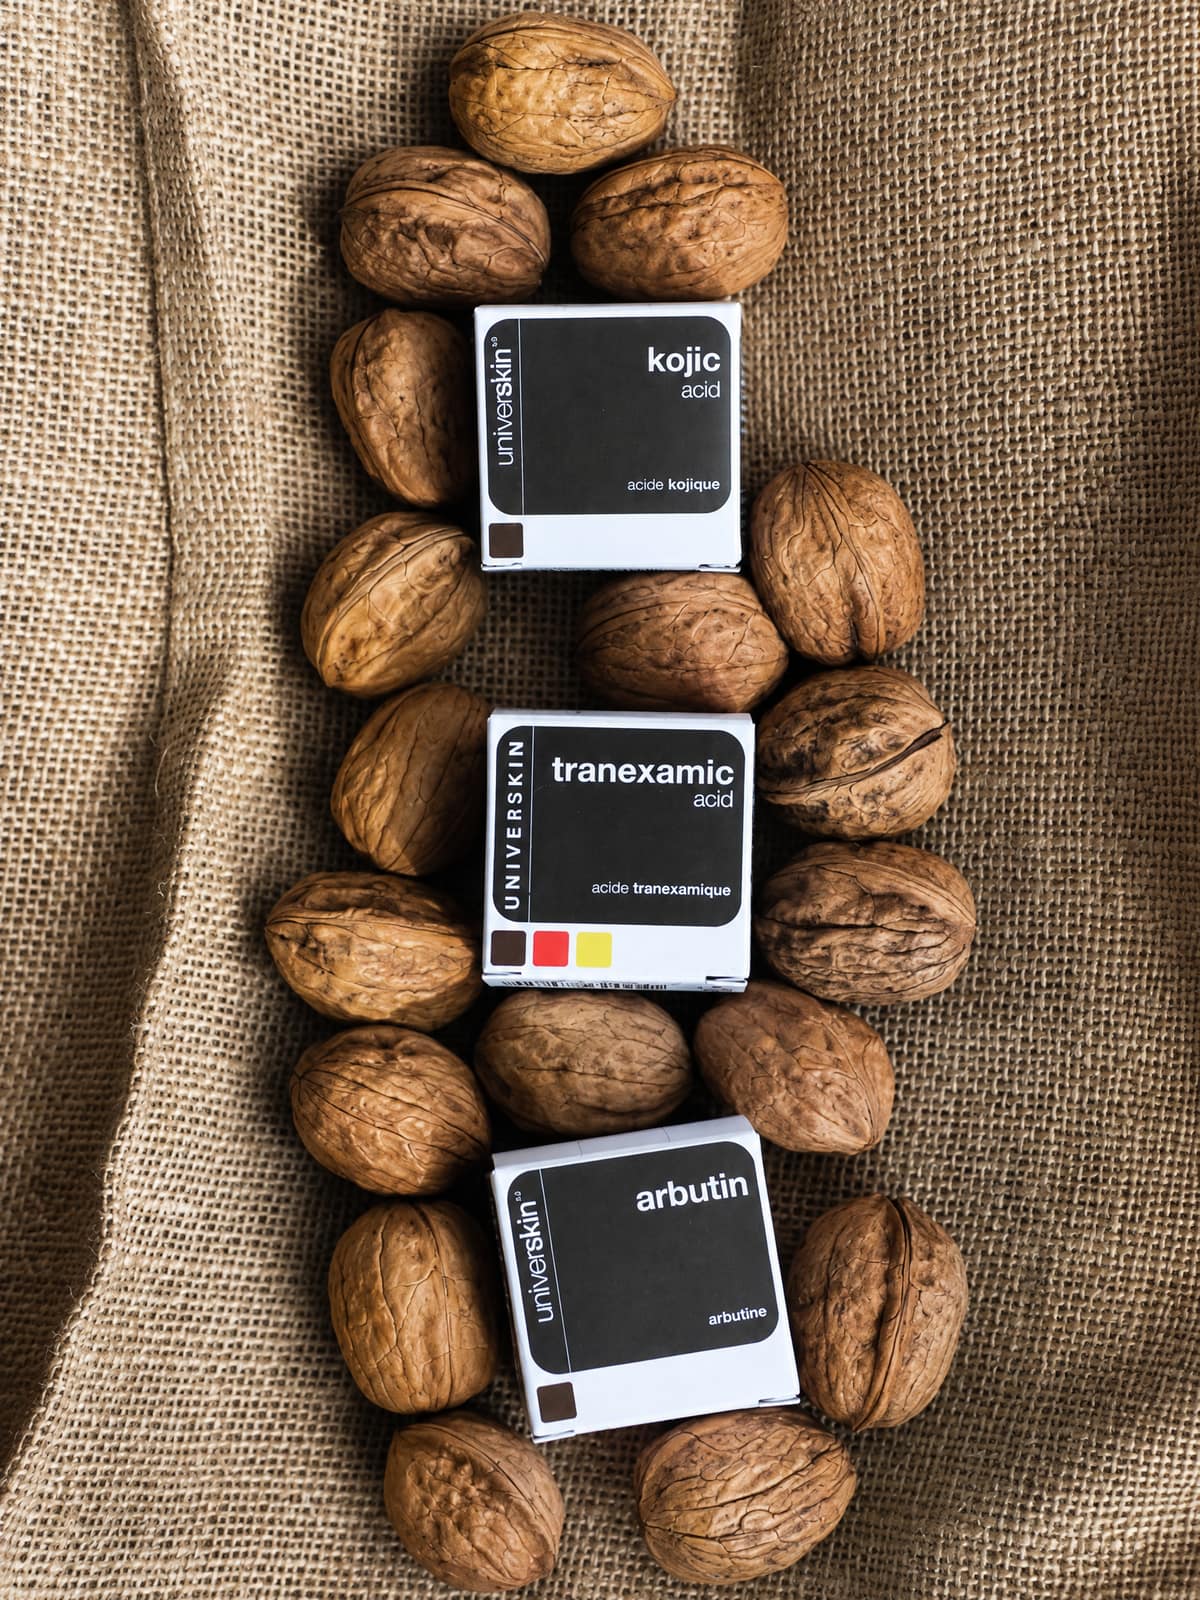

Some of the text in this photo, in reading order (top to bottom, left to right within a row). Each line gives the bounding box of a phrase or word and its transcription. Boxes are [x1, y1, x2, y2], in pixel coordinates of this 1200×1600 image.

[648, 346, 720, 377] kojic
[681, 380, 720, 398] acid
[490, 349, 513, 465] universkin
[627, 478, 720, 492] acide kojique
[552, 757, 734, 785] tranexamic
[694, 790, 733, 807] acid
[505, 742, 523, 909] UNIVERSKIN
[591, 881, 731, 898] acide tranexamique
[636, 1173, 748, 1211] arbutin
[516, 1200, 553, 1323] universkin
[709, 1308, 767, 1325] arbutine
